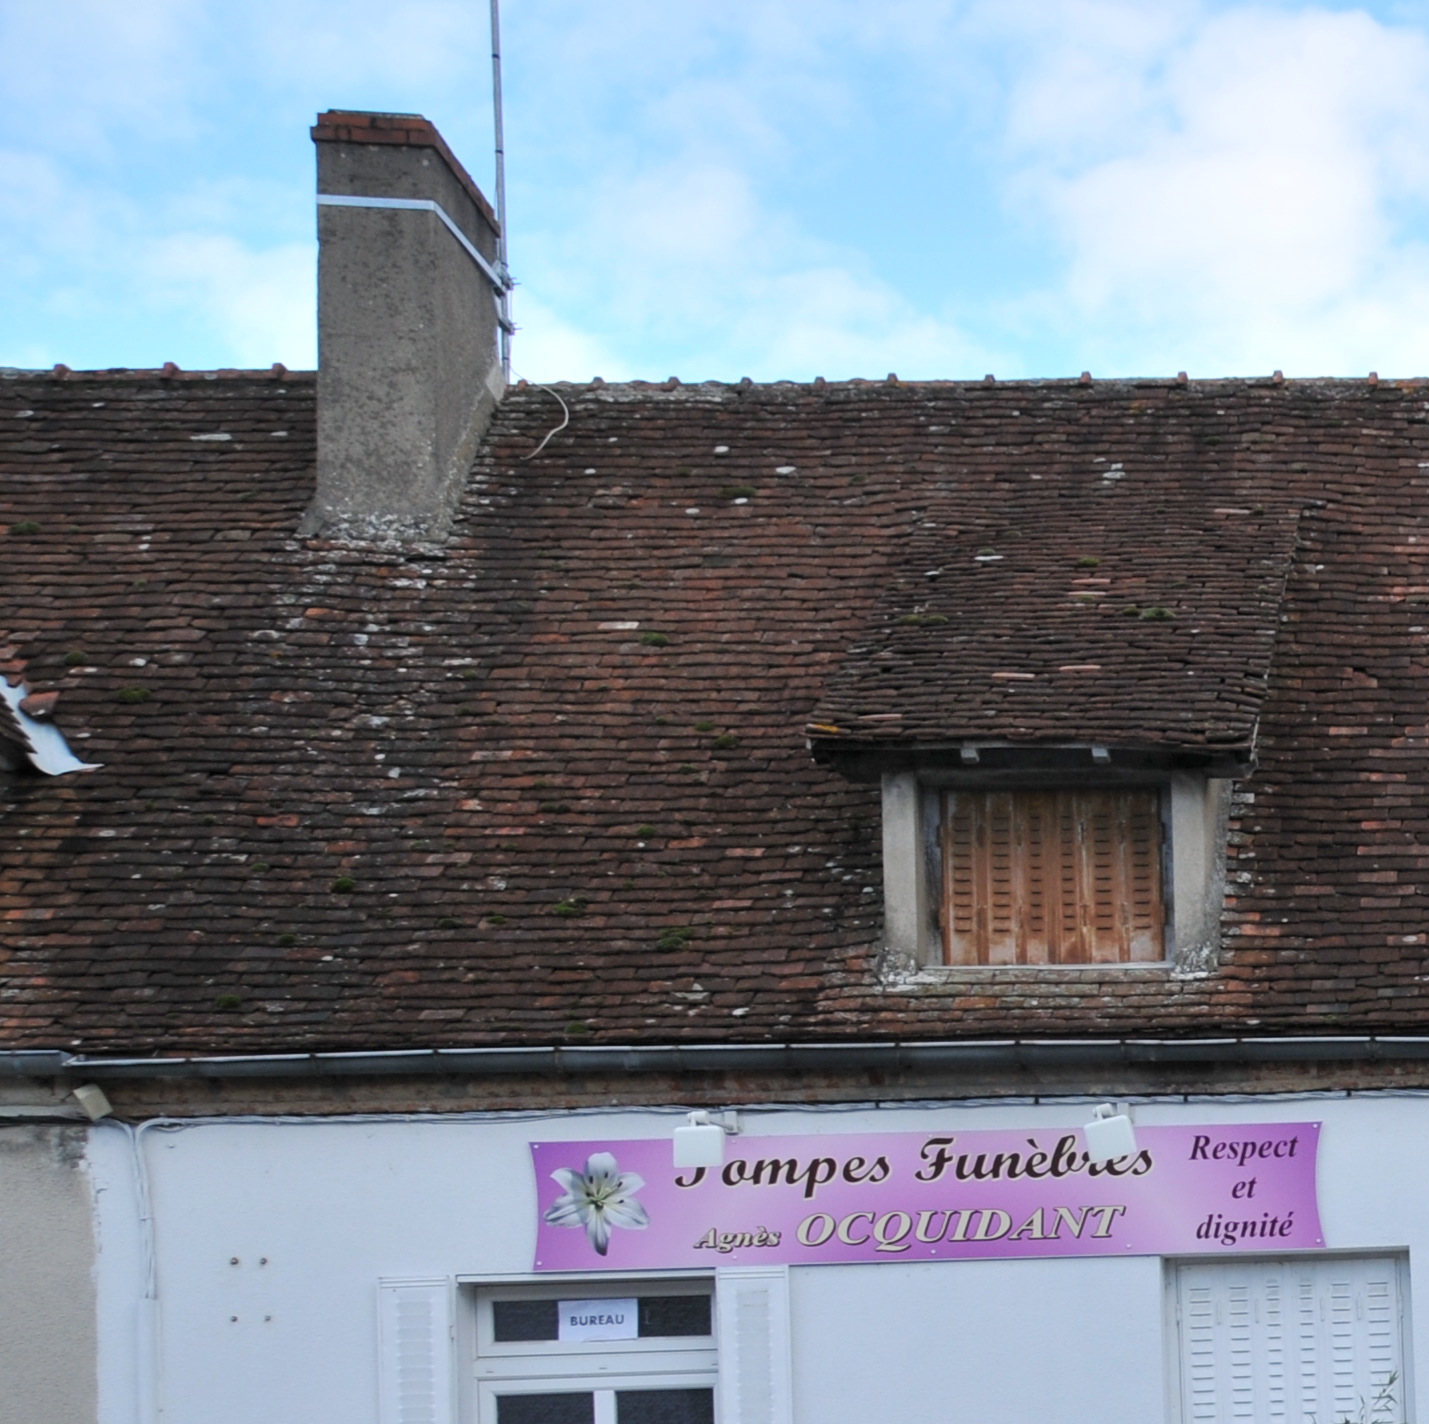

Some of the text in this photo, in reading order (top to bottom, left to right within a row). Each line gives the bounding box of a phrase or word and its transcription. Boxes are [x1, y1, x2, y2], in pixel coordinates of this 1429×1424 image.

[1188, 1134, 1298, 1166] Respect
[1232, 1177, 1257, 1199] et
[694, 1204, 1126, 1253] Agnès OCQUIDANT
[1196, 1211, 1293, 1245] dignité
[569, 1314, 625, 1327] BUREAU
